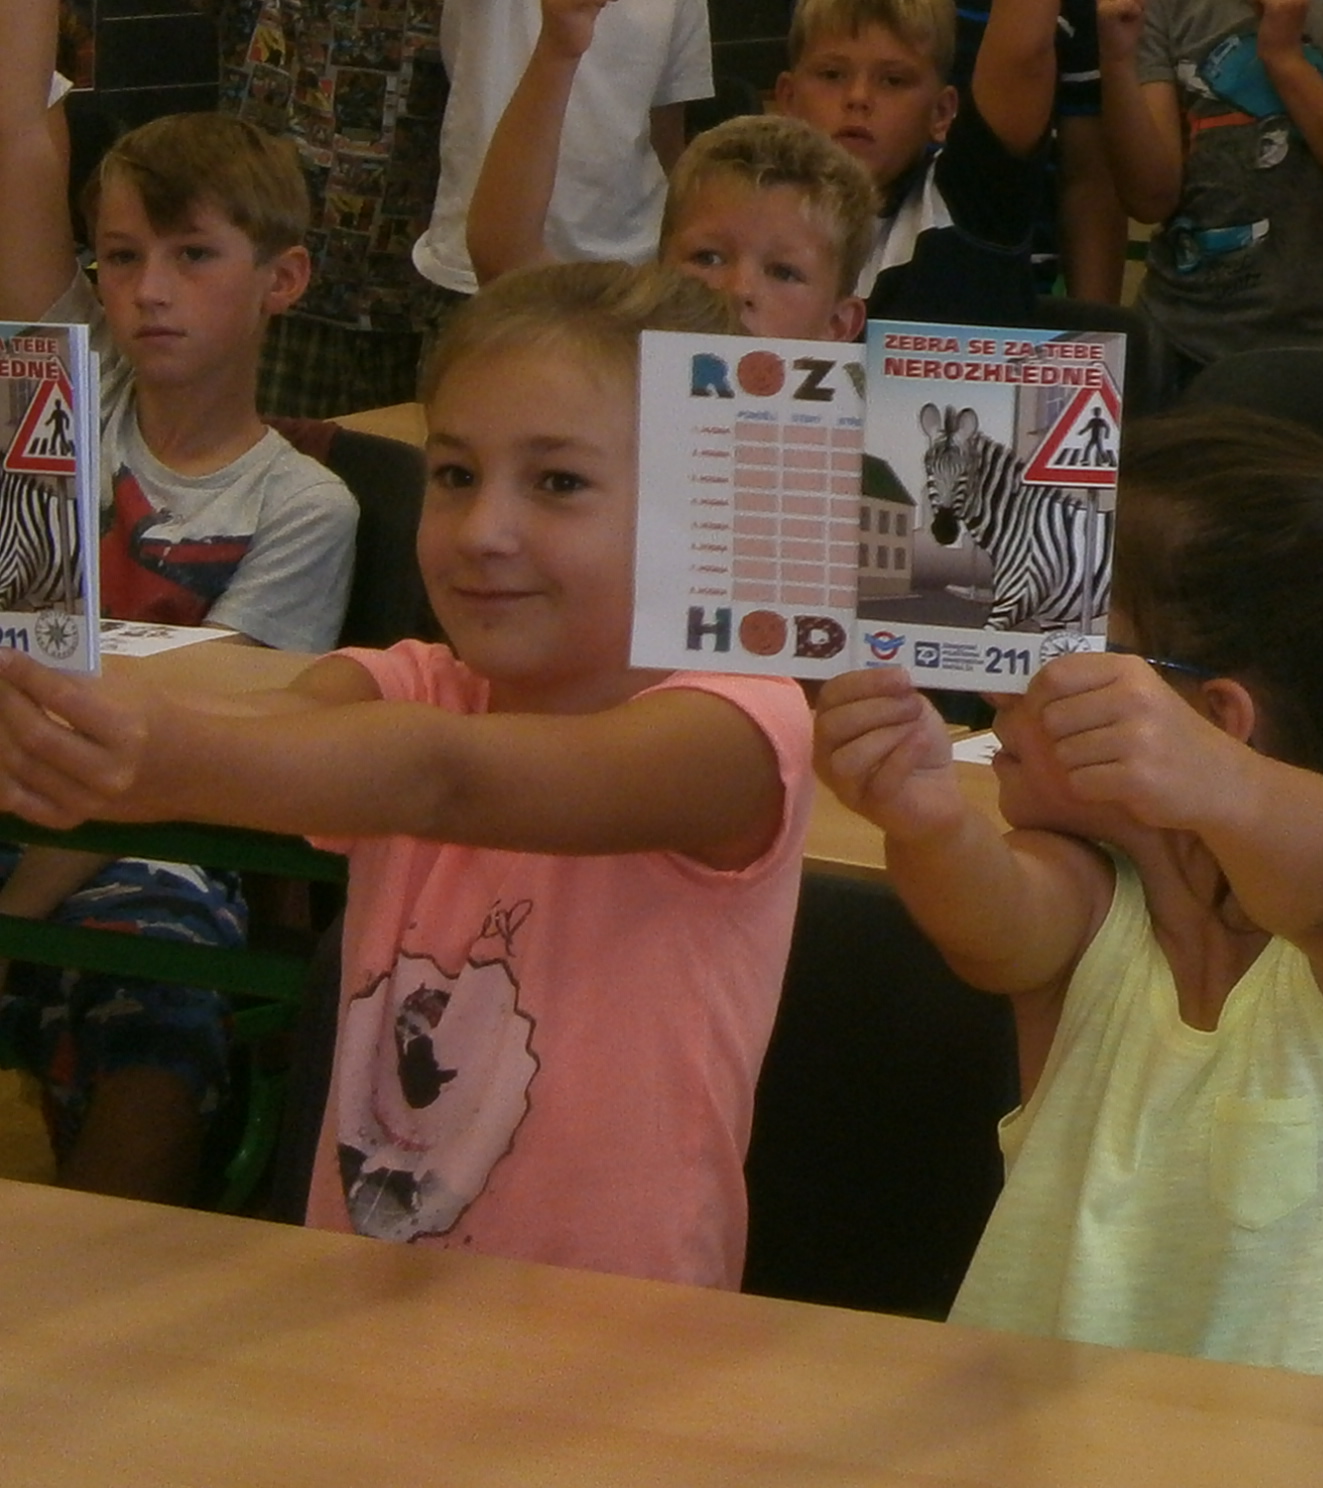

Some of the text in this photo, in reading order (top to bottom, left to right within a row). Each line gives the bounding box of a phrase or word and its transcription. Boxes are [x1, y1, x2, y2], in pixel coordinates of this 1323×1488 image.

[11, 337, 57, 354] TEBE
[884, 333, 1104, 361] ZEBRA SE ZA TEBE
[985, 646, 1031, 675] 211
